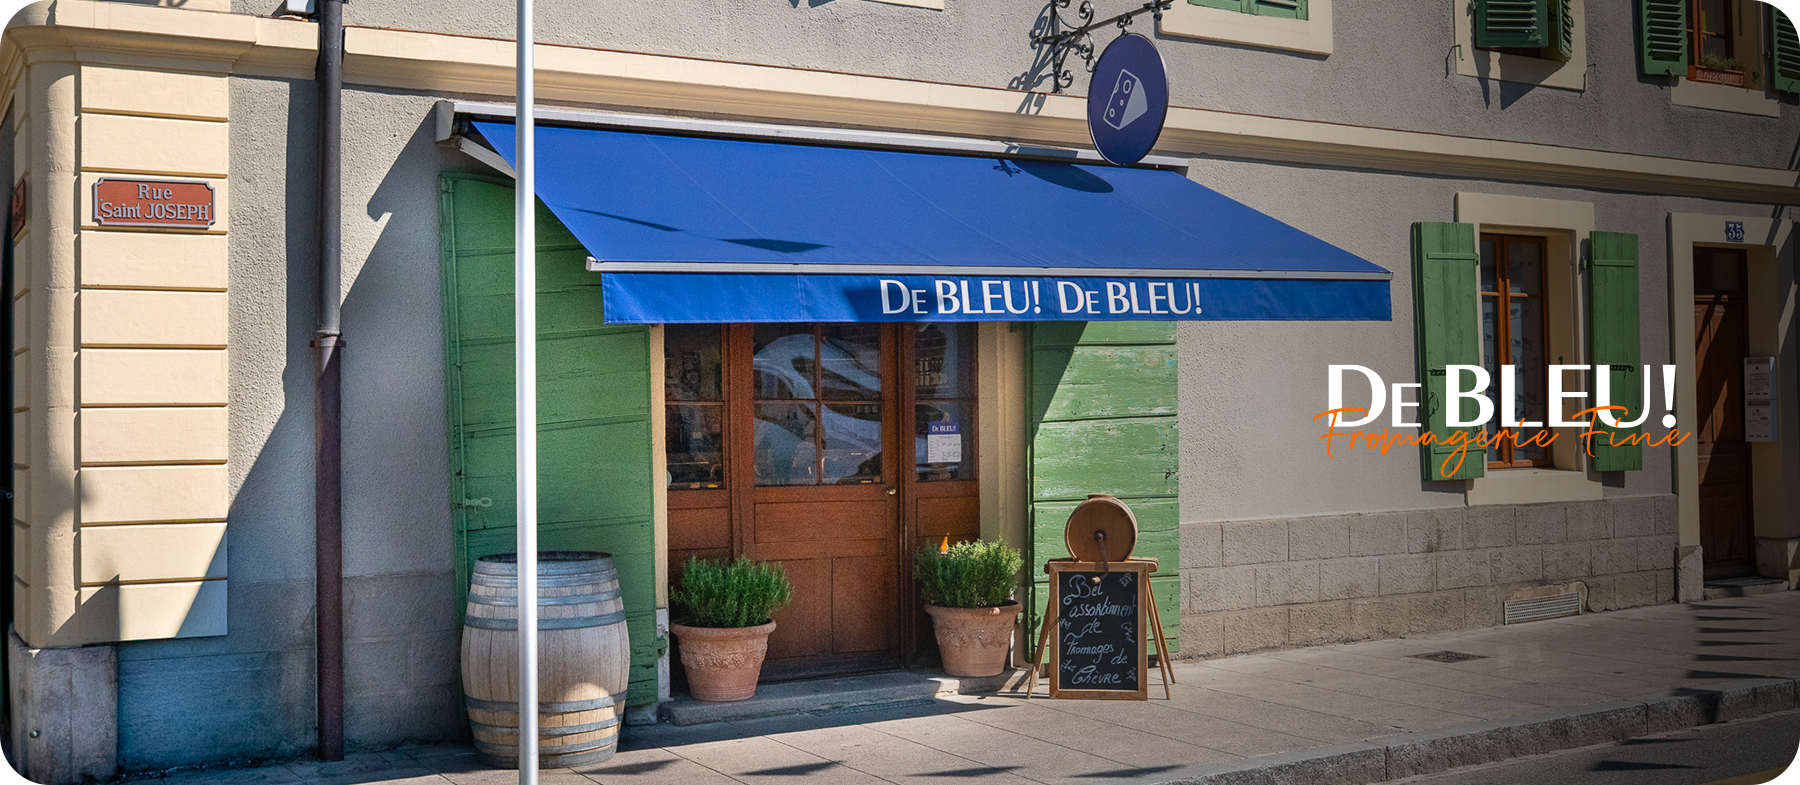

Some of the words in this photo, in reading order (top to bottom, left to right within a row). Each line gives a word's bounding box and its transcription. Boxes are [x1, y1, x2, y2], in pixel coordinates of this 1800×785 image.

[137, 183, 173, 200] Rue
[101, 202, 141, 219] Saint
[144, 203, 210, 221] JOSEPH
[1728, 223, 1743, 240] 35
[934, 279, 1042, 315] BLEU!
[1105, 281, 1203, 316] BLEU!
[1063, 574, 1103, 606] Bel
[1081, 618, 1103, 634] de
[1063, 632, 1115, 664] Fromages
[1110, 647, 1128, 665] de
